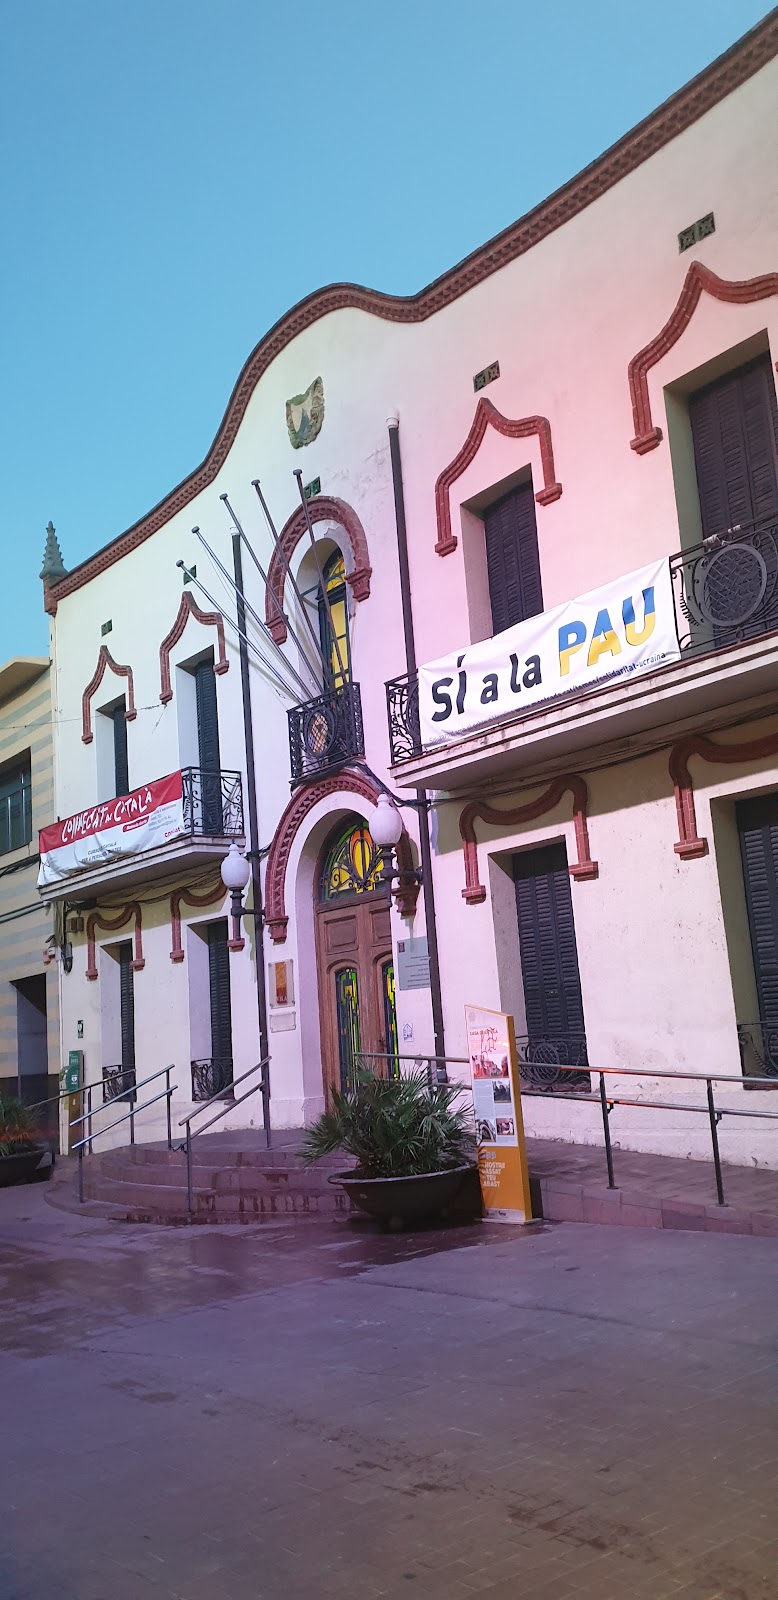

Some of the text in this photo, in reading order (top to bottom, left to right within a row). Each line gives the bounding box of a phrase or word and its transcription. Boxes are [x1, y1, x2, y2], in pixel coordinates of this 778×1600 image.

[430, 585, 658, 723] SÍ a la PAU
[113, 787, 152, 822] CATALÀ
